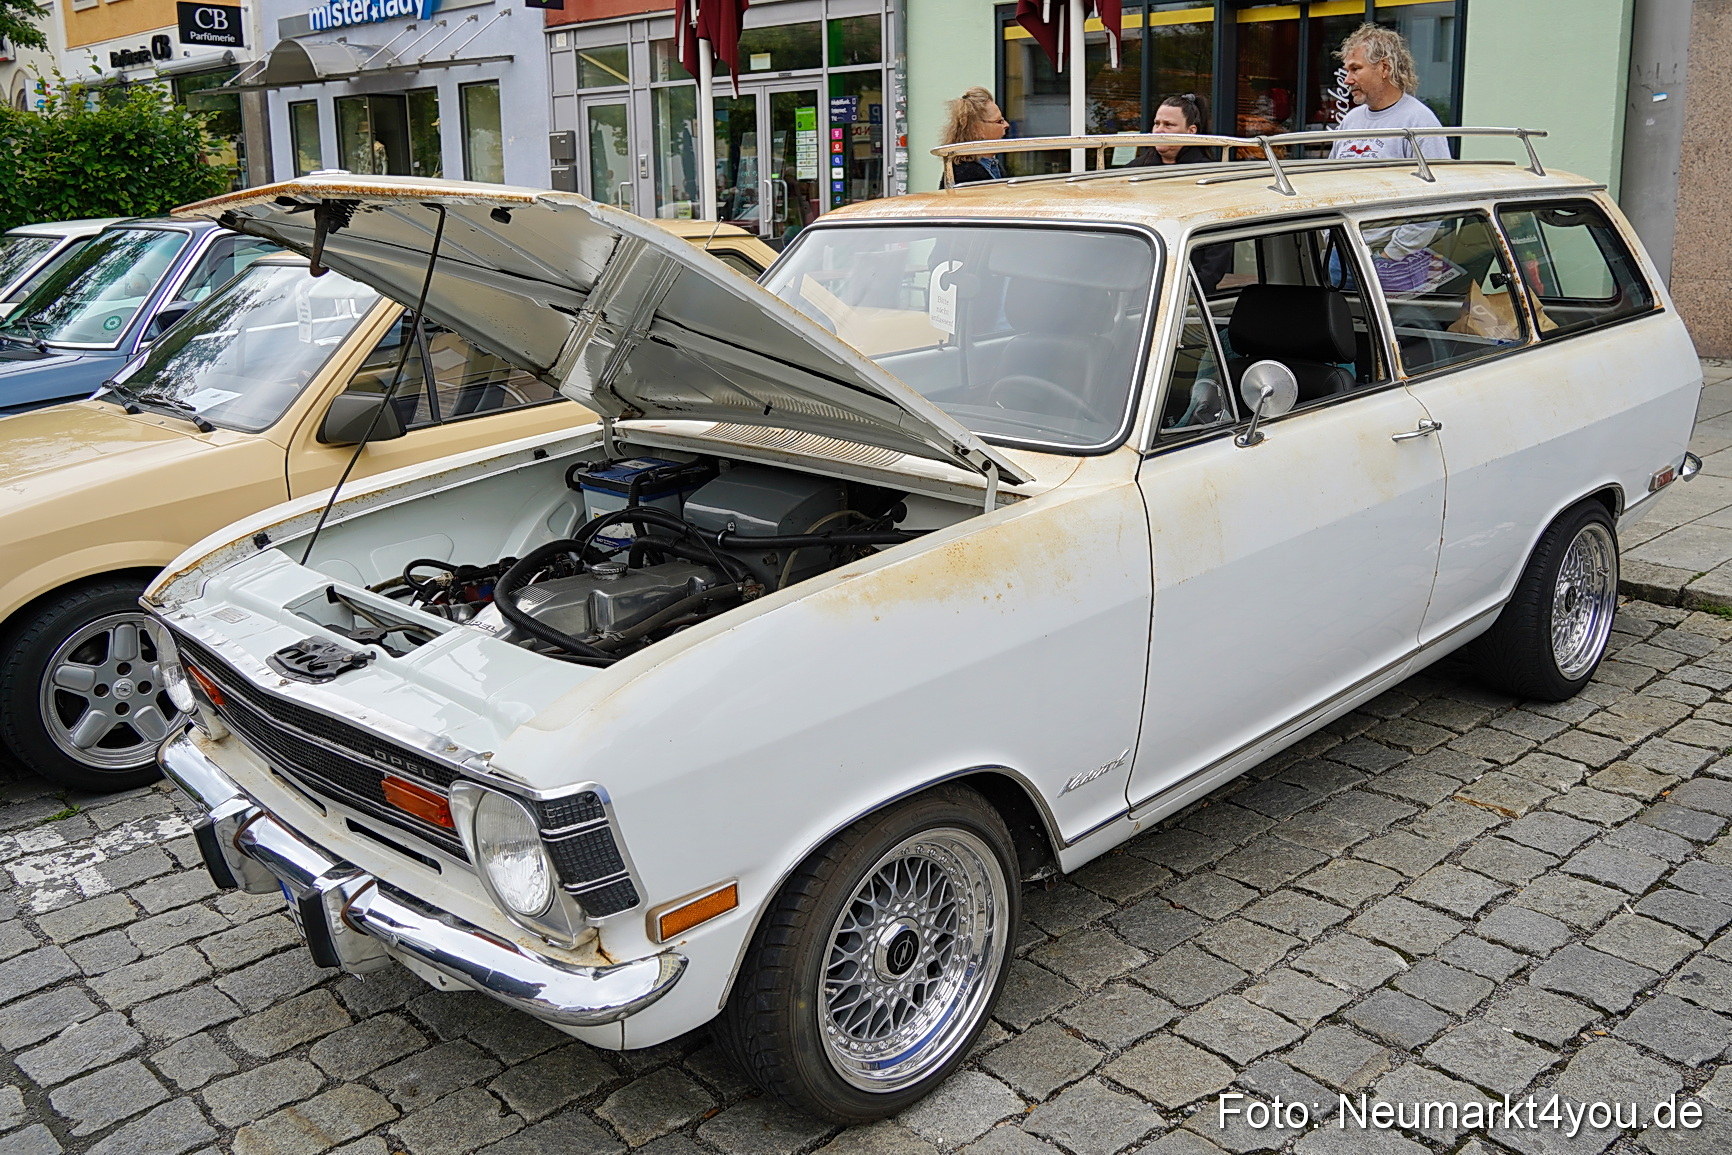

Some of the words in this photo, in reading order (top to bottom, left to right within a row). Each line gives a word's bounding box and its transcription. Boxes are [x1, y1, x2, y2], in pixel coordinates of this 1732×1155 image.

[194, 7, 229, 30] CB
[309, 0, 371, 30] mister
[380, 0, 424, 20] lady
[189, 30, 236, 43] Parfümerie
[938, 296, 949, 305] Bitte
[936, 306, 949, 315] nicht
[374, 749, 435, 780] OPEL
